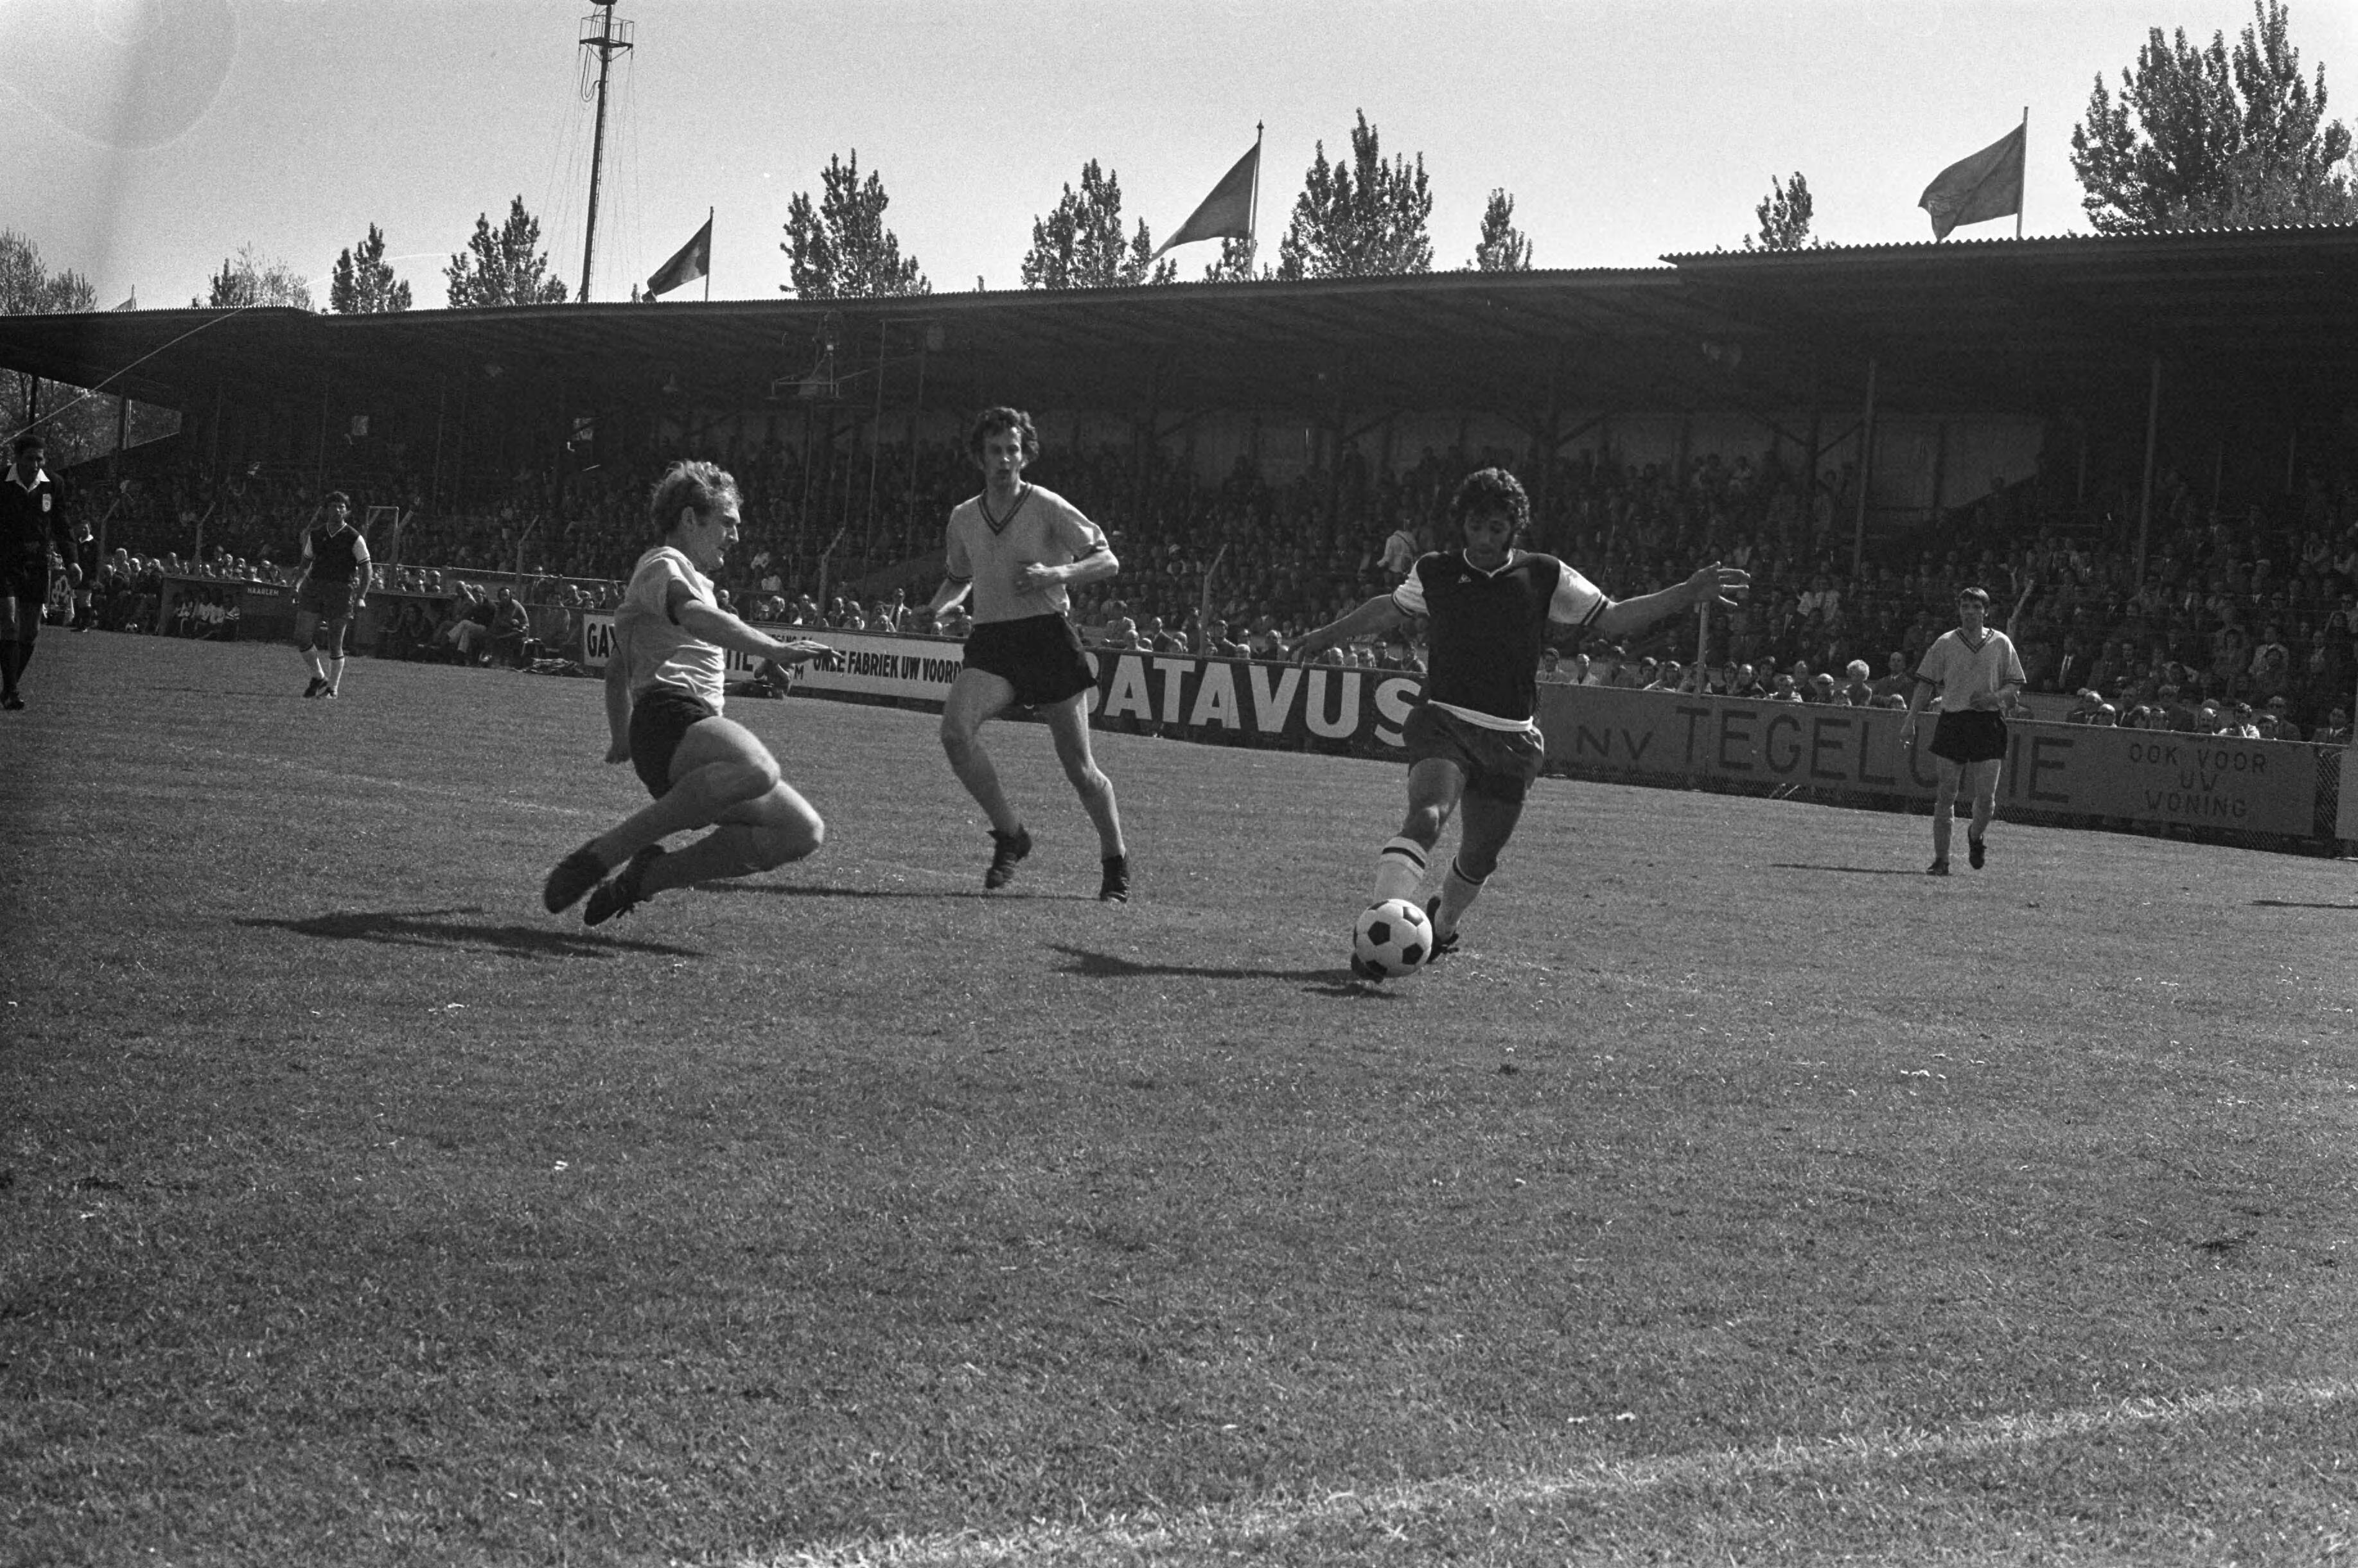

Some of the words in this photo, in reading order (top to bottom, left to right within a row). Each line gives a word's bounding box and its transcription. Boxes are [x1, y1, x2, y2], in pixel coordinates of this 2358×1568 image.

[247, 587, 279, 597] HAARLEM
[847, 651, 899, 678] FABRIEK
[901, 655, 921, 680] UW
[1676, 707, 2074, 804] TEGELUIE
[2129, 743, 2179, 766] OOK
[2197, 748, 2266, 773] VOOR
[2181, 770, 2218, 792] UW
[2145, 789, 2247, 818] WONING
